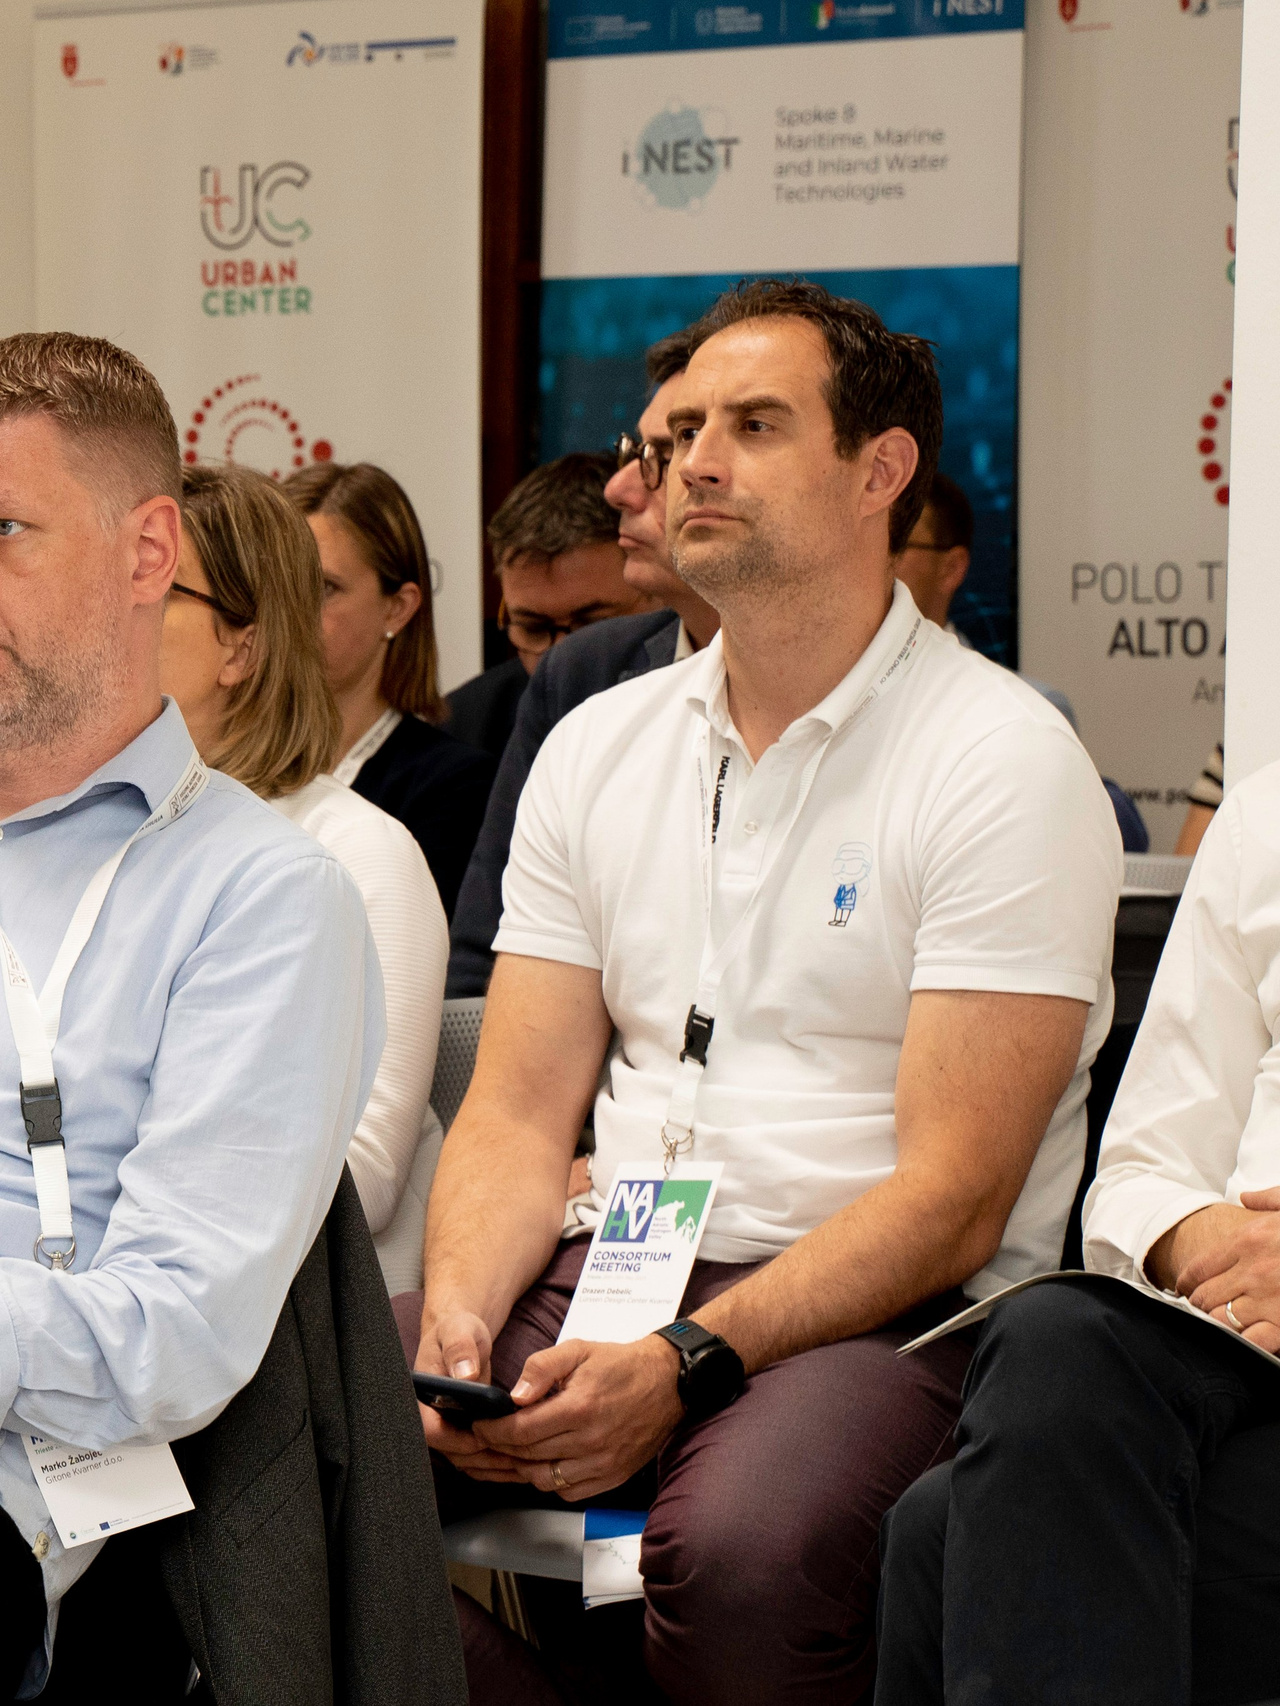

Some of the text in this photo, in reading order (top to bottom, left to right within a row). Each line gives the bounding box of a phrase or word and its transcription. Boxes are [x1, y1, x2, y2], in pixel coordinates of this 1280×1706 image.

[775, 105, 838, 127] Spoke
[873, 127, 946, 147] Marine
[774, 151, 950, 179] and Inland Water
[776, 182, 905, 205] Technologies
[201, 258, 297, 288] URBAN
[202, 286, 312, 317] CENTER
[1072, 561, 1182, 605] POLO
[1108, 617, 1209, 659] ALTO
[717, 755, 730, 783] KARL
[590, 1262, 641, 1273] MEETING
[594, 1251, 671, 1261] CONSORTIUM
[41, 1460, 67, 1474] Marko
[45, 1455, 124, 1485] Gitone Kvarner d.o.o.
